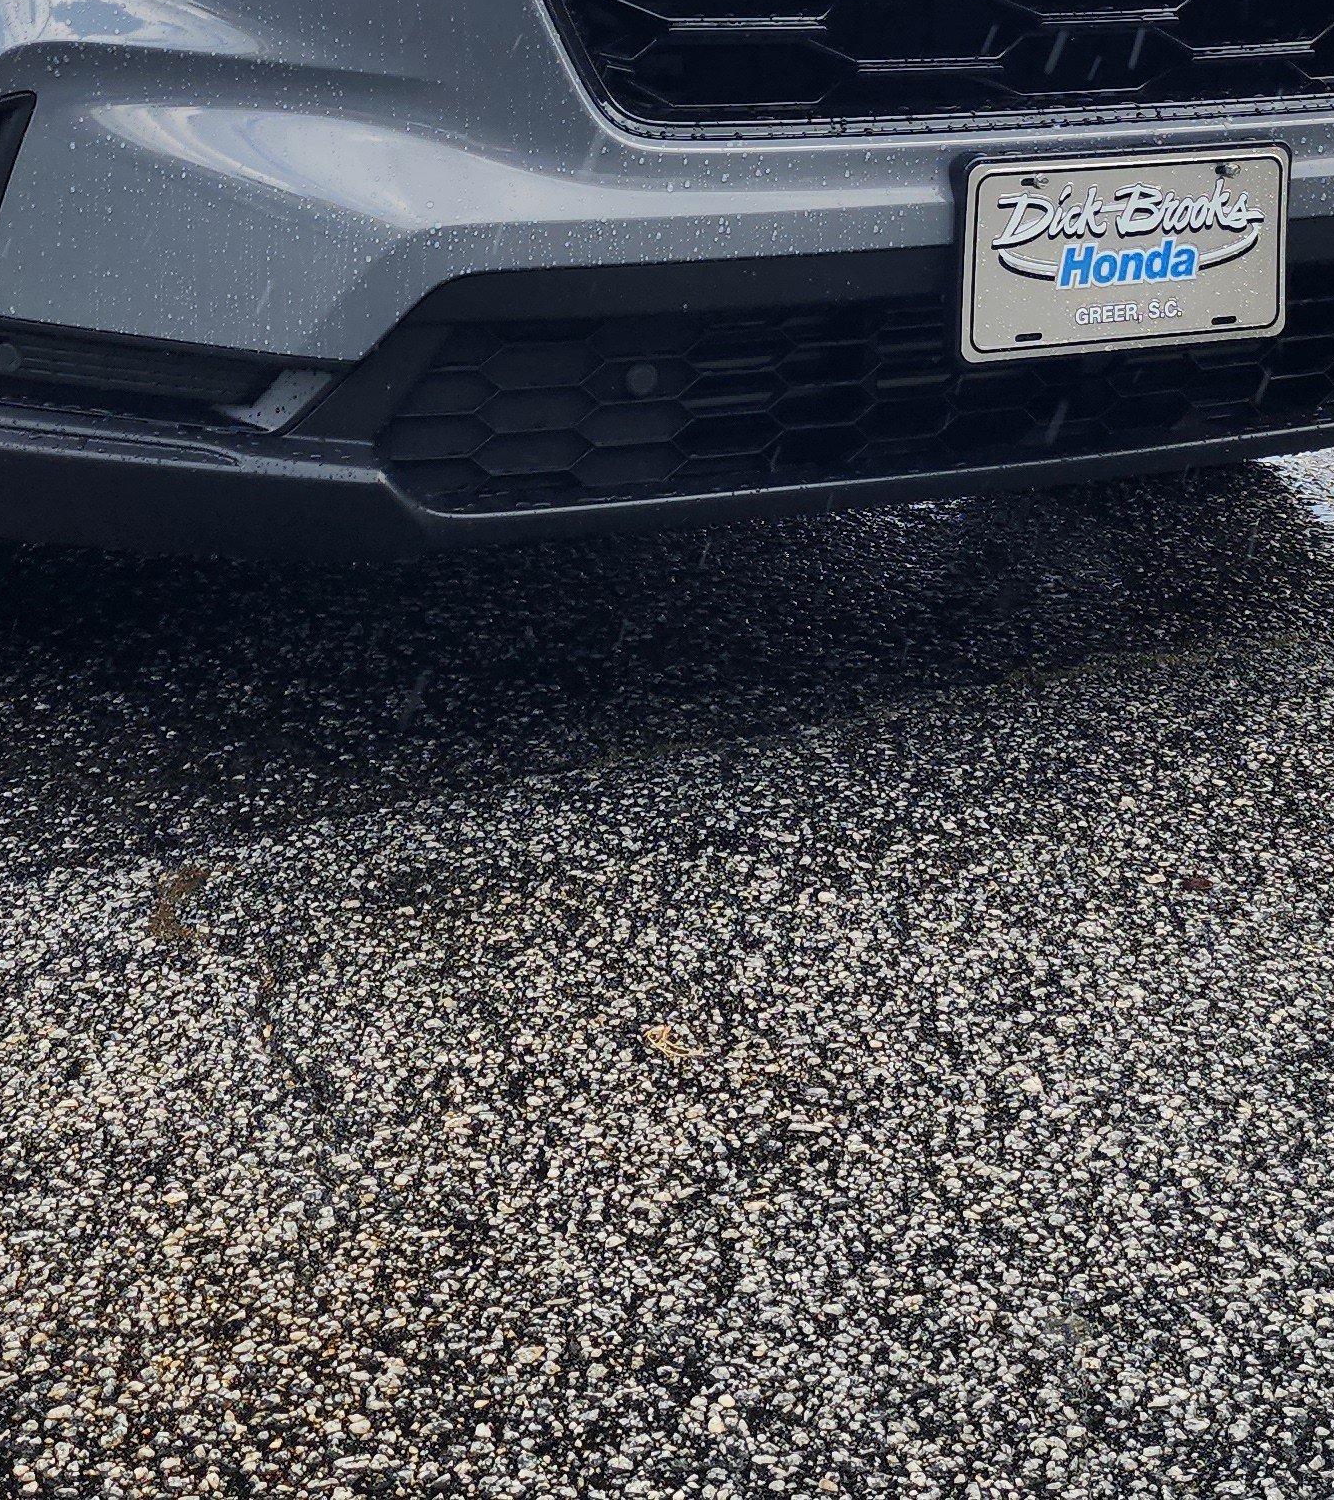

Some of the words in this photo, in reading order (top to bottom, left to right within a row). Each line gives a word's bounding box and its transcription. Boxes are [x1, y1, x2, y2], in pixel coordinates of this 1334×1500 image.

[991, 183, 1108, 250] Dick
[1113, 178, 1264, 238] Brooks
[1057, 237, 1199, 289] Honda
[1075, 302, 1143, 325] GREER,
[1148, 297, 1182, 319] S.C.
